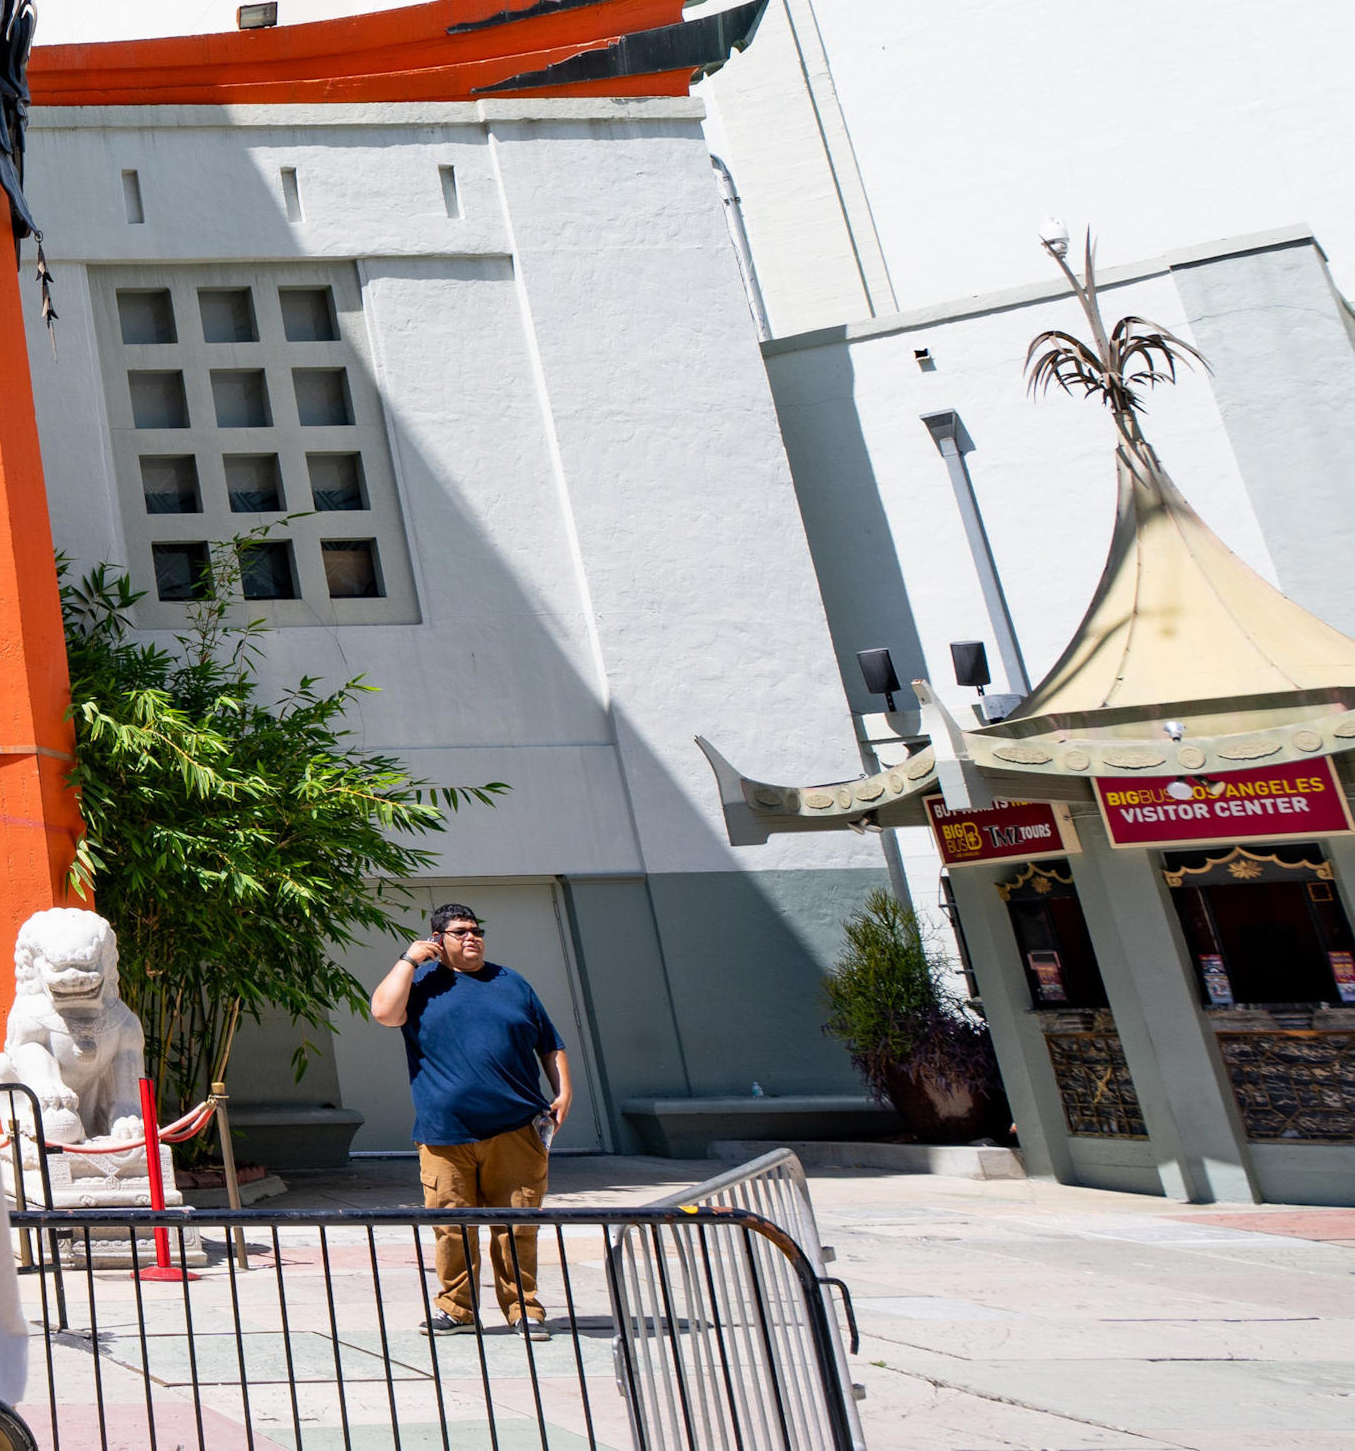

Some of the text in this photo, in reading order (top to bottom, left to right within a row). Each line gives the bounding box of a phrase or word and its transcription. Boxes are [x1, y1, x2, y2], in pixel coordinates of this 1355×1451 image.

[1187, 783, 1222, 800] OS
[1225, 777, 1326, 799] ANGELES
[1119, 796, 1310, 824] VISITOR CENTER
[942, 823, 964, 840] BIG
[983, 823, 1052, 848] TMZ TOURS
[946, 838, 969, 854] BUS
